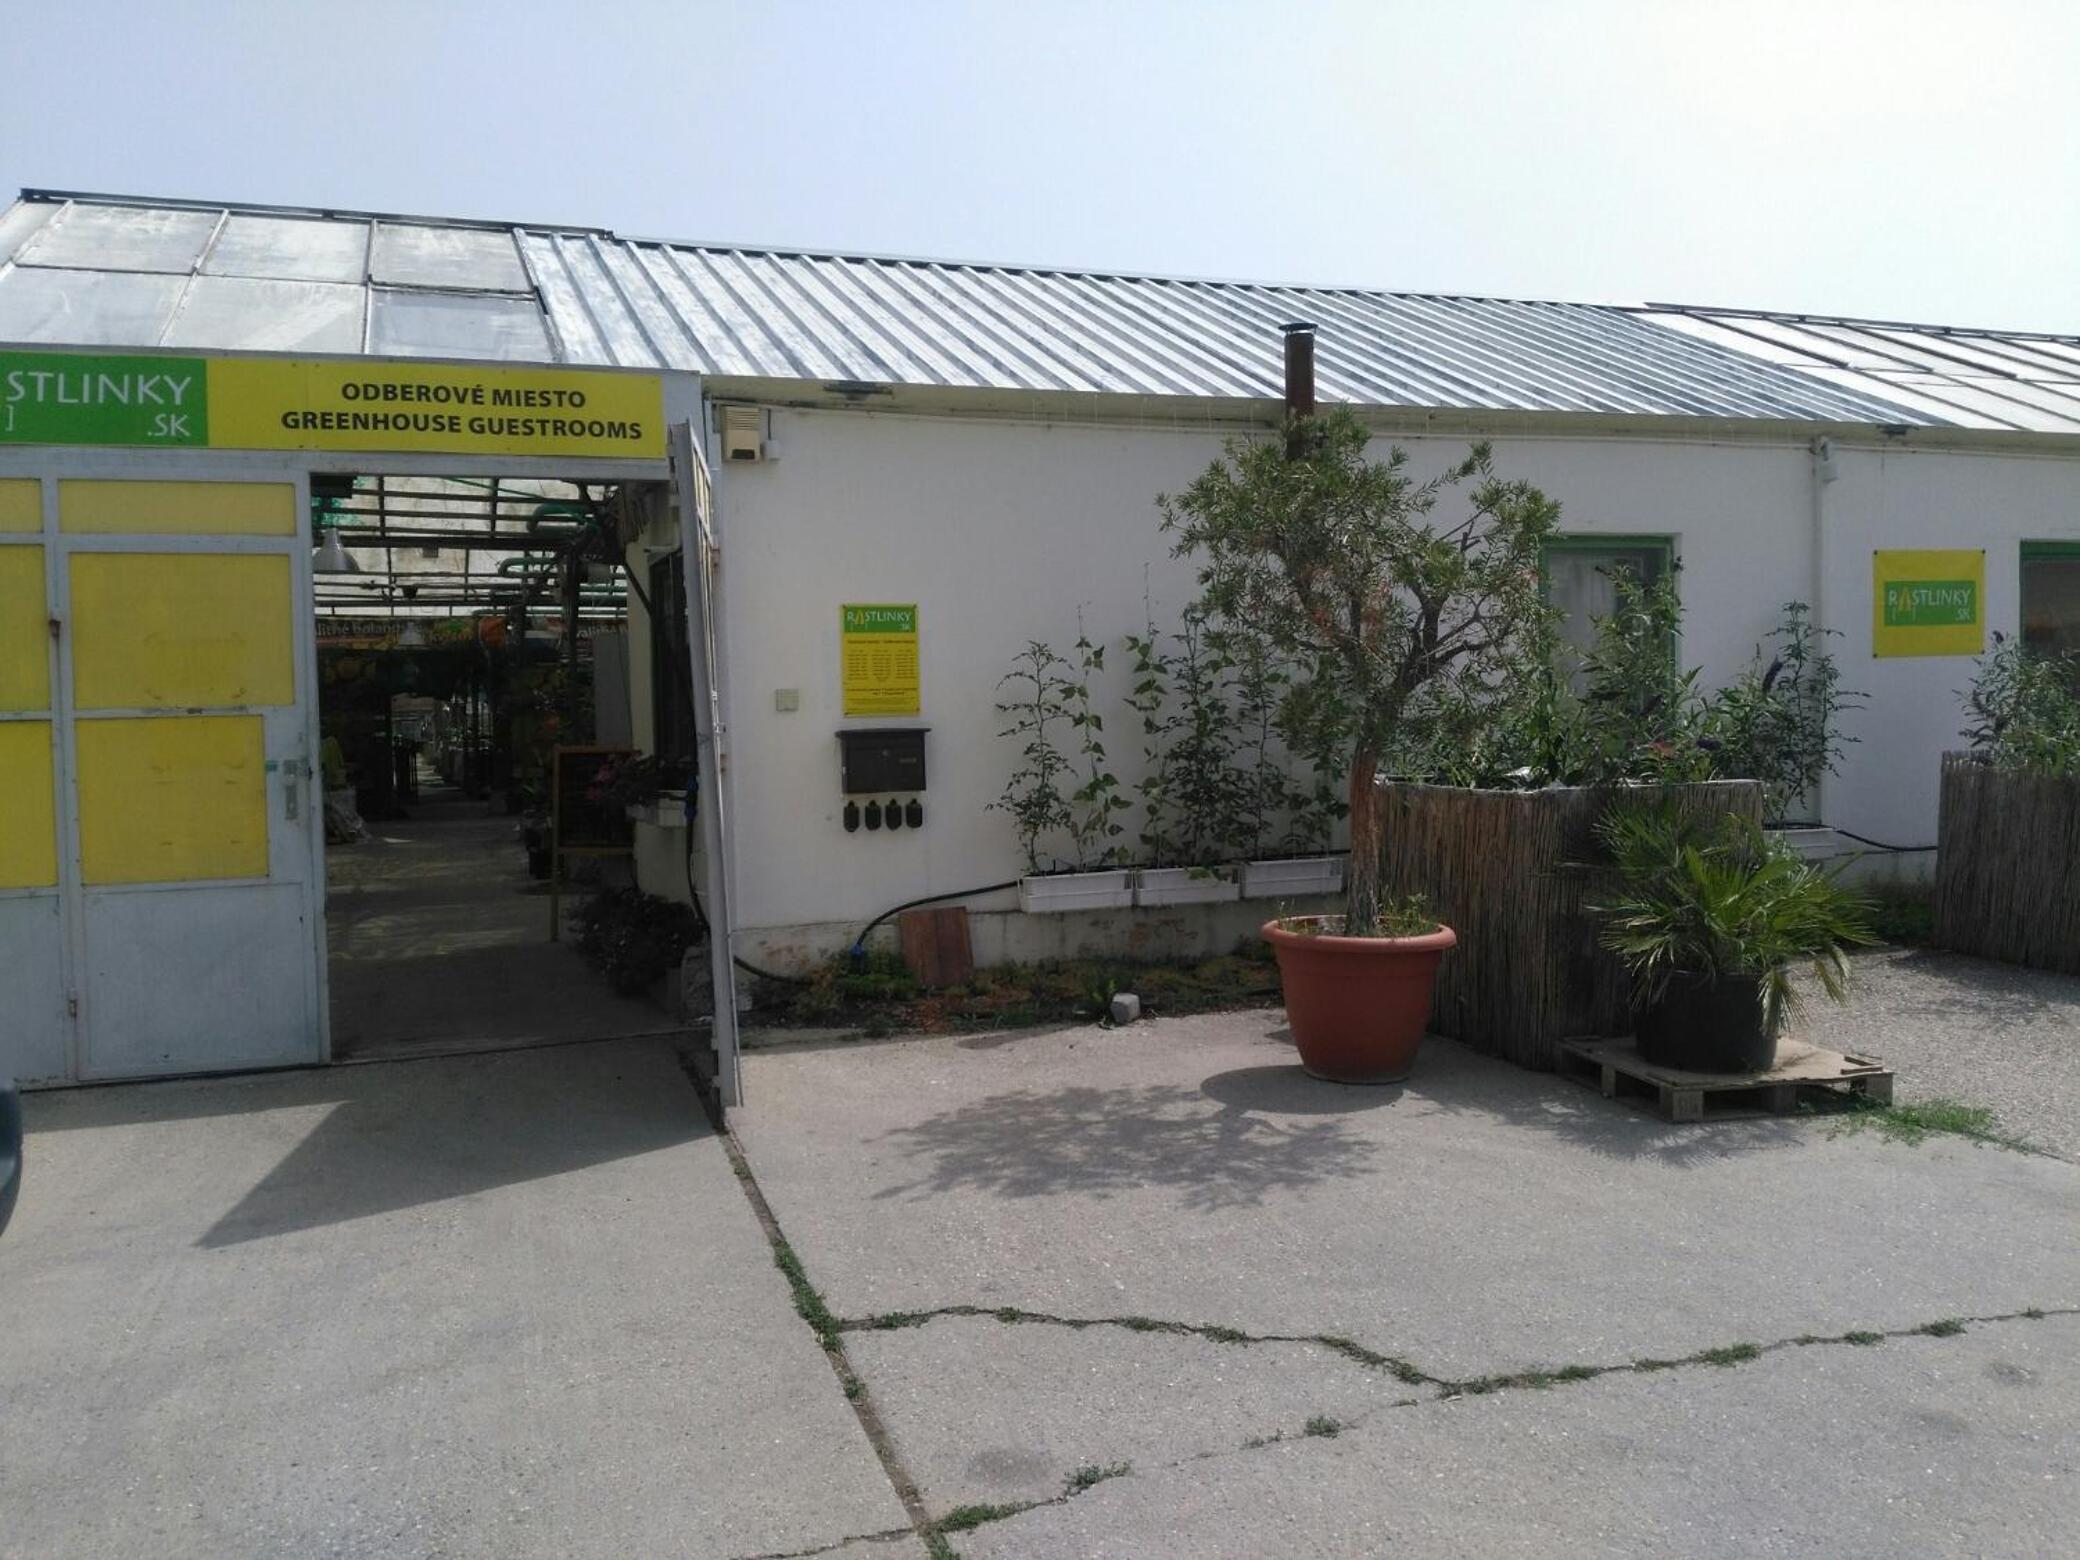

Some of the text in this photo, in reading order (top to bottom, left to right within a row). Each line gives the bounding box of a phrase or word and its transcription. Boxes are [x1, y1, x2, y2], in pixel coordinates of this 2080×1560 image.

[6, 370, 192, 406] STLINKY
[341, 383, 586, 408] ODBEROVÉ MIESTO
[147, 412, 191, 437] .SK
[281, 411, 642, 440] GREENHOUSE GUESTROOMS
[1888, 588, 1970, 609] RASTLINKY
[847, 610, 911, 623] RASTLINKY
